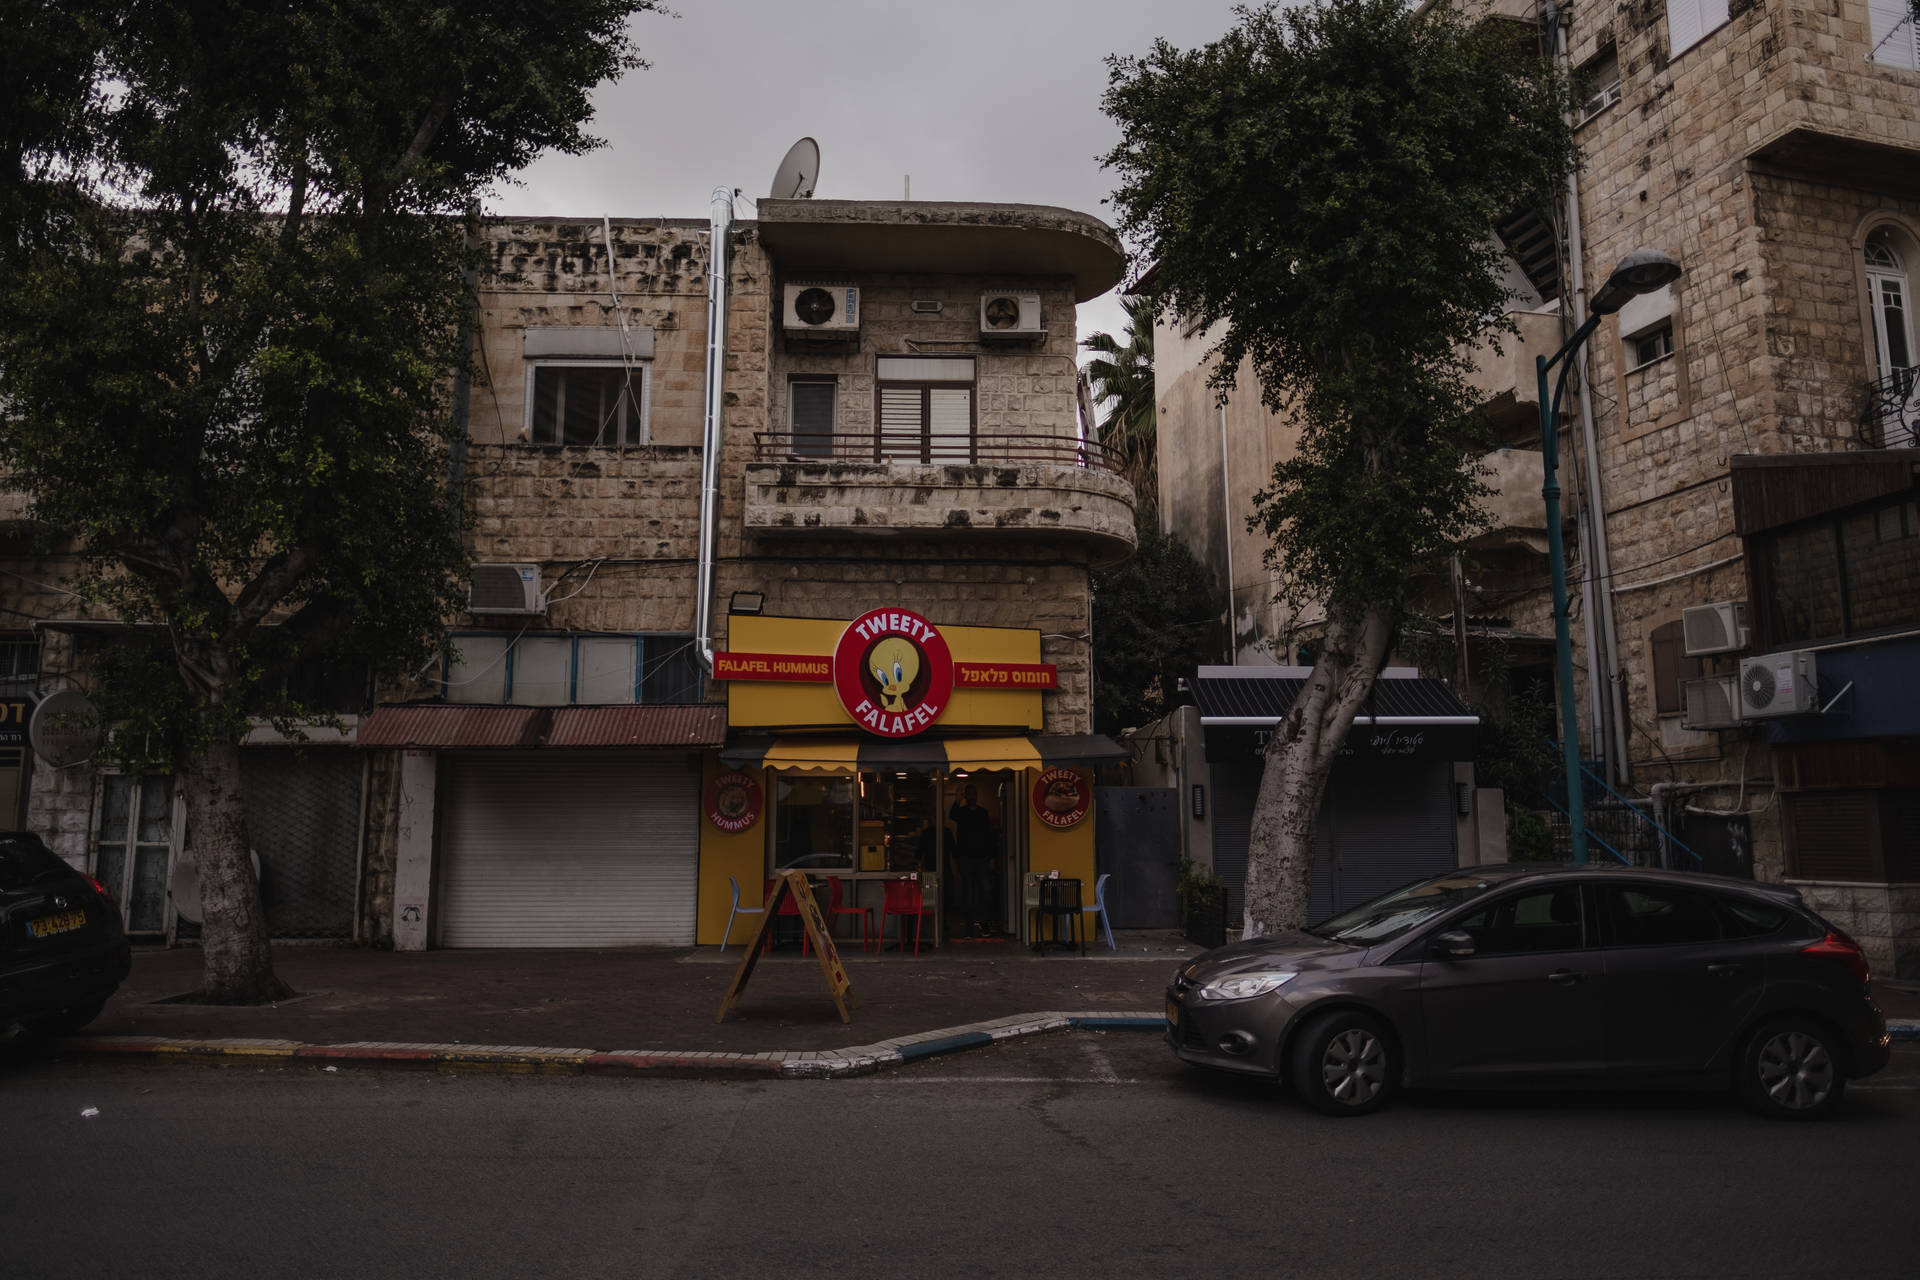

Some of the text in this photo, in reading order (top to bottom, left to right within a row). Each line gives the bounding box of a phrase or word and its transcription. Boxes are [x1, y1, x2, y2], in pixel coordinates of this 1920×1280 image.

[855, 613, 937, 643] TWEETY
[717, 659, 830, 676] FALAFEL HUMMUS
[961, 666, 1051, 684] חומוס פלאפל
[856, 699, 939, 733] FALAFEL
[713, 774, 756, 789] TWEETY
[1040, 769, 1081, 785] TWEETY
[711, 811, 755, 831] HUMMUS
[1042, 809, 1084, 825] FALAFEL
